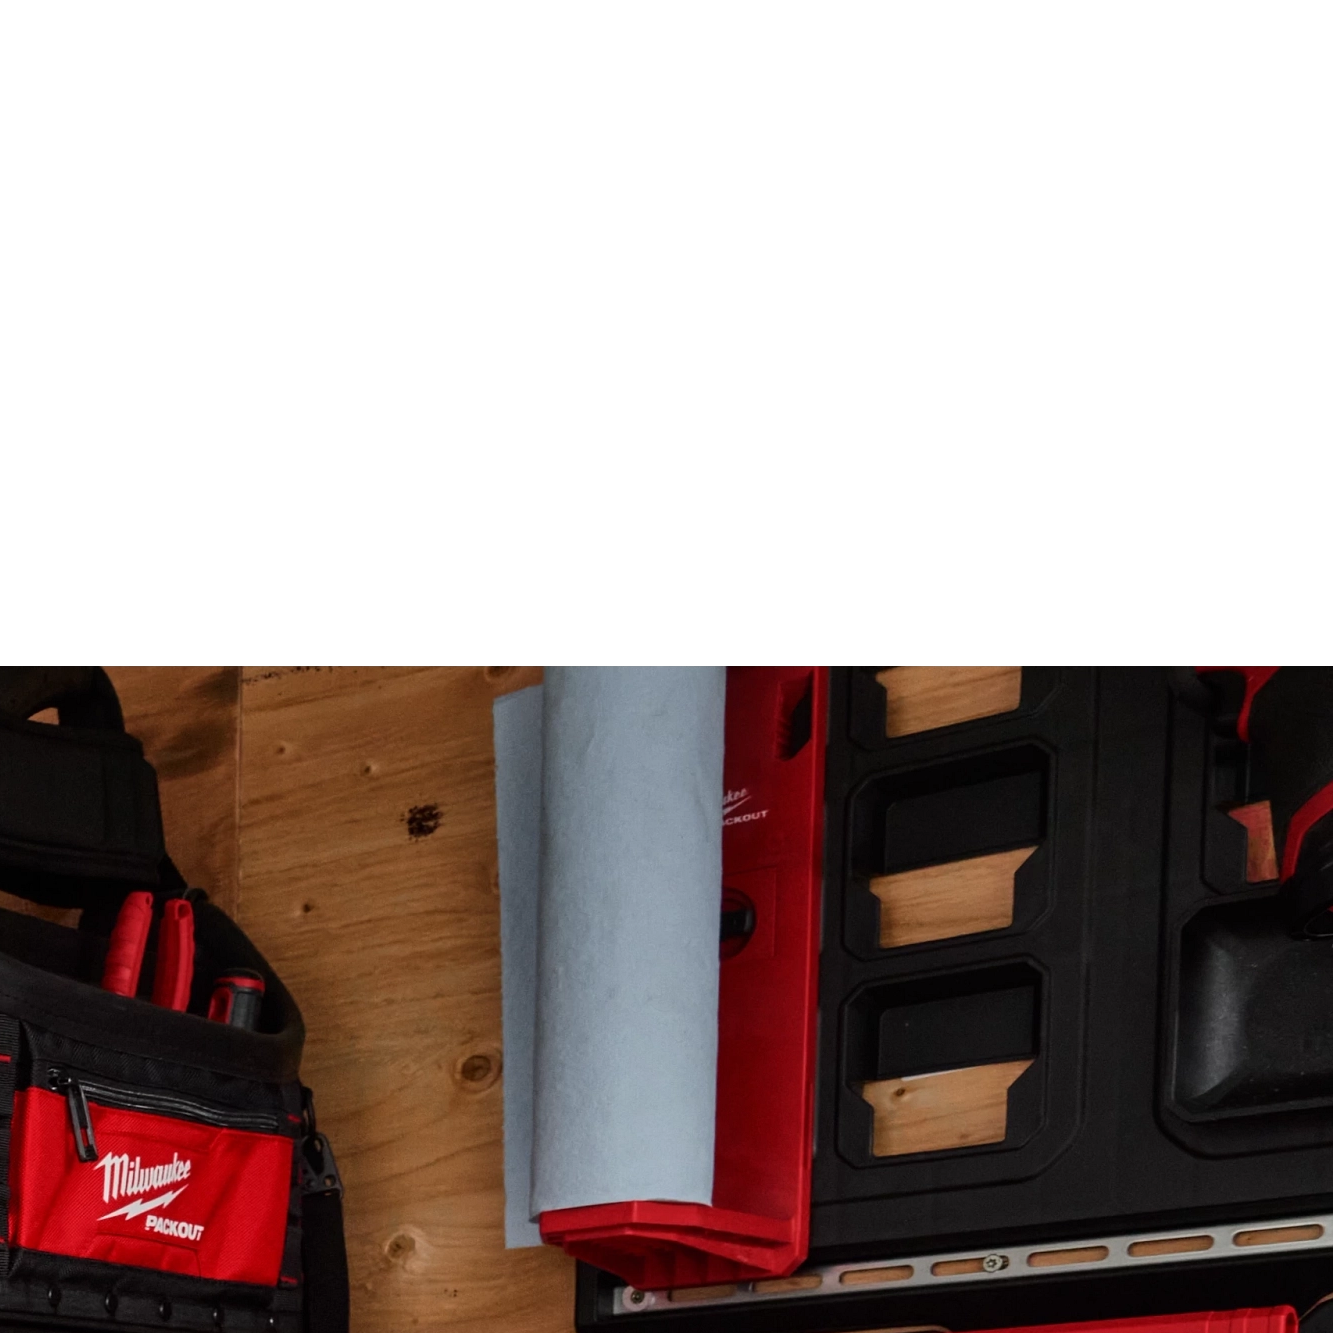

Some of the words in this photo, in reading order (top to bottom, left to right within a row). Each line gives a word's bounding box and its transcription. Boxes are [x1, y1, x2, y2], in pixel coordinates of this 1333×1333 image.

[723, 809, 770, 826] CKOUT
[93, 1151, 192, 1204] Milwaukee
[144, 1214, 205, 1242] PACKOUT
